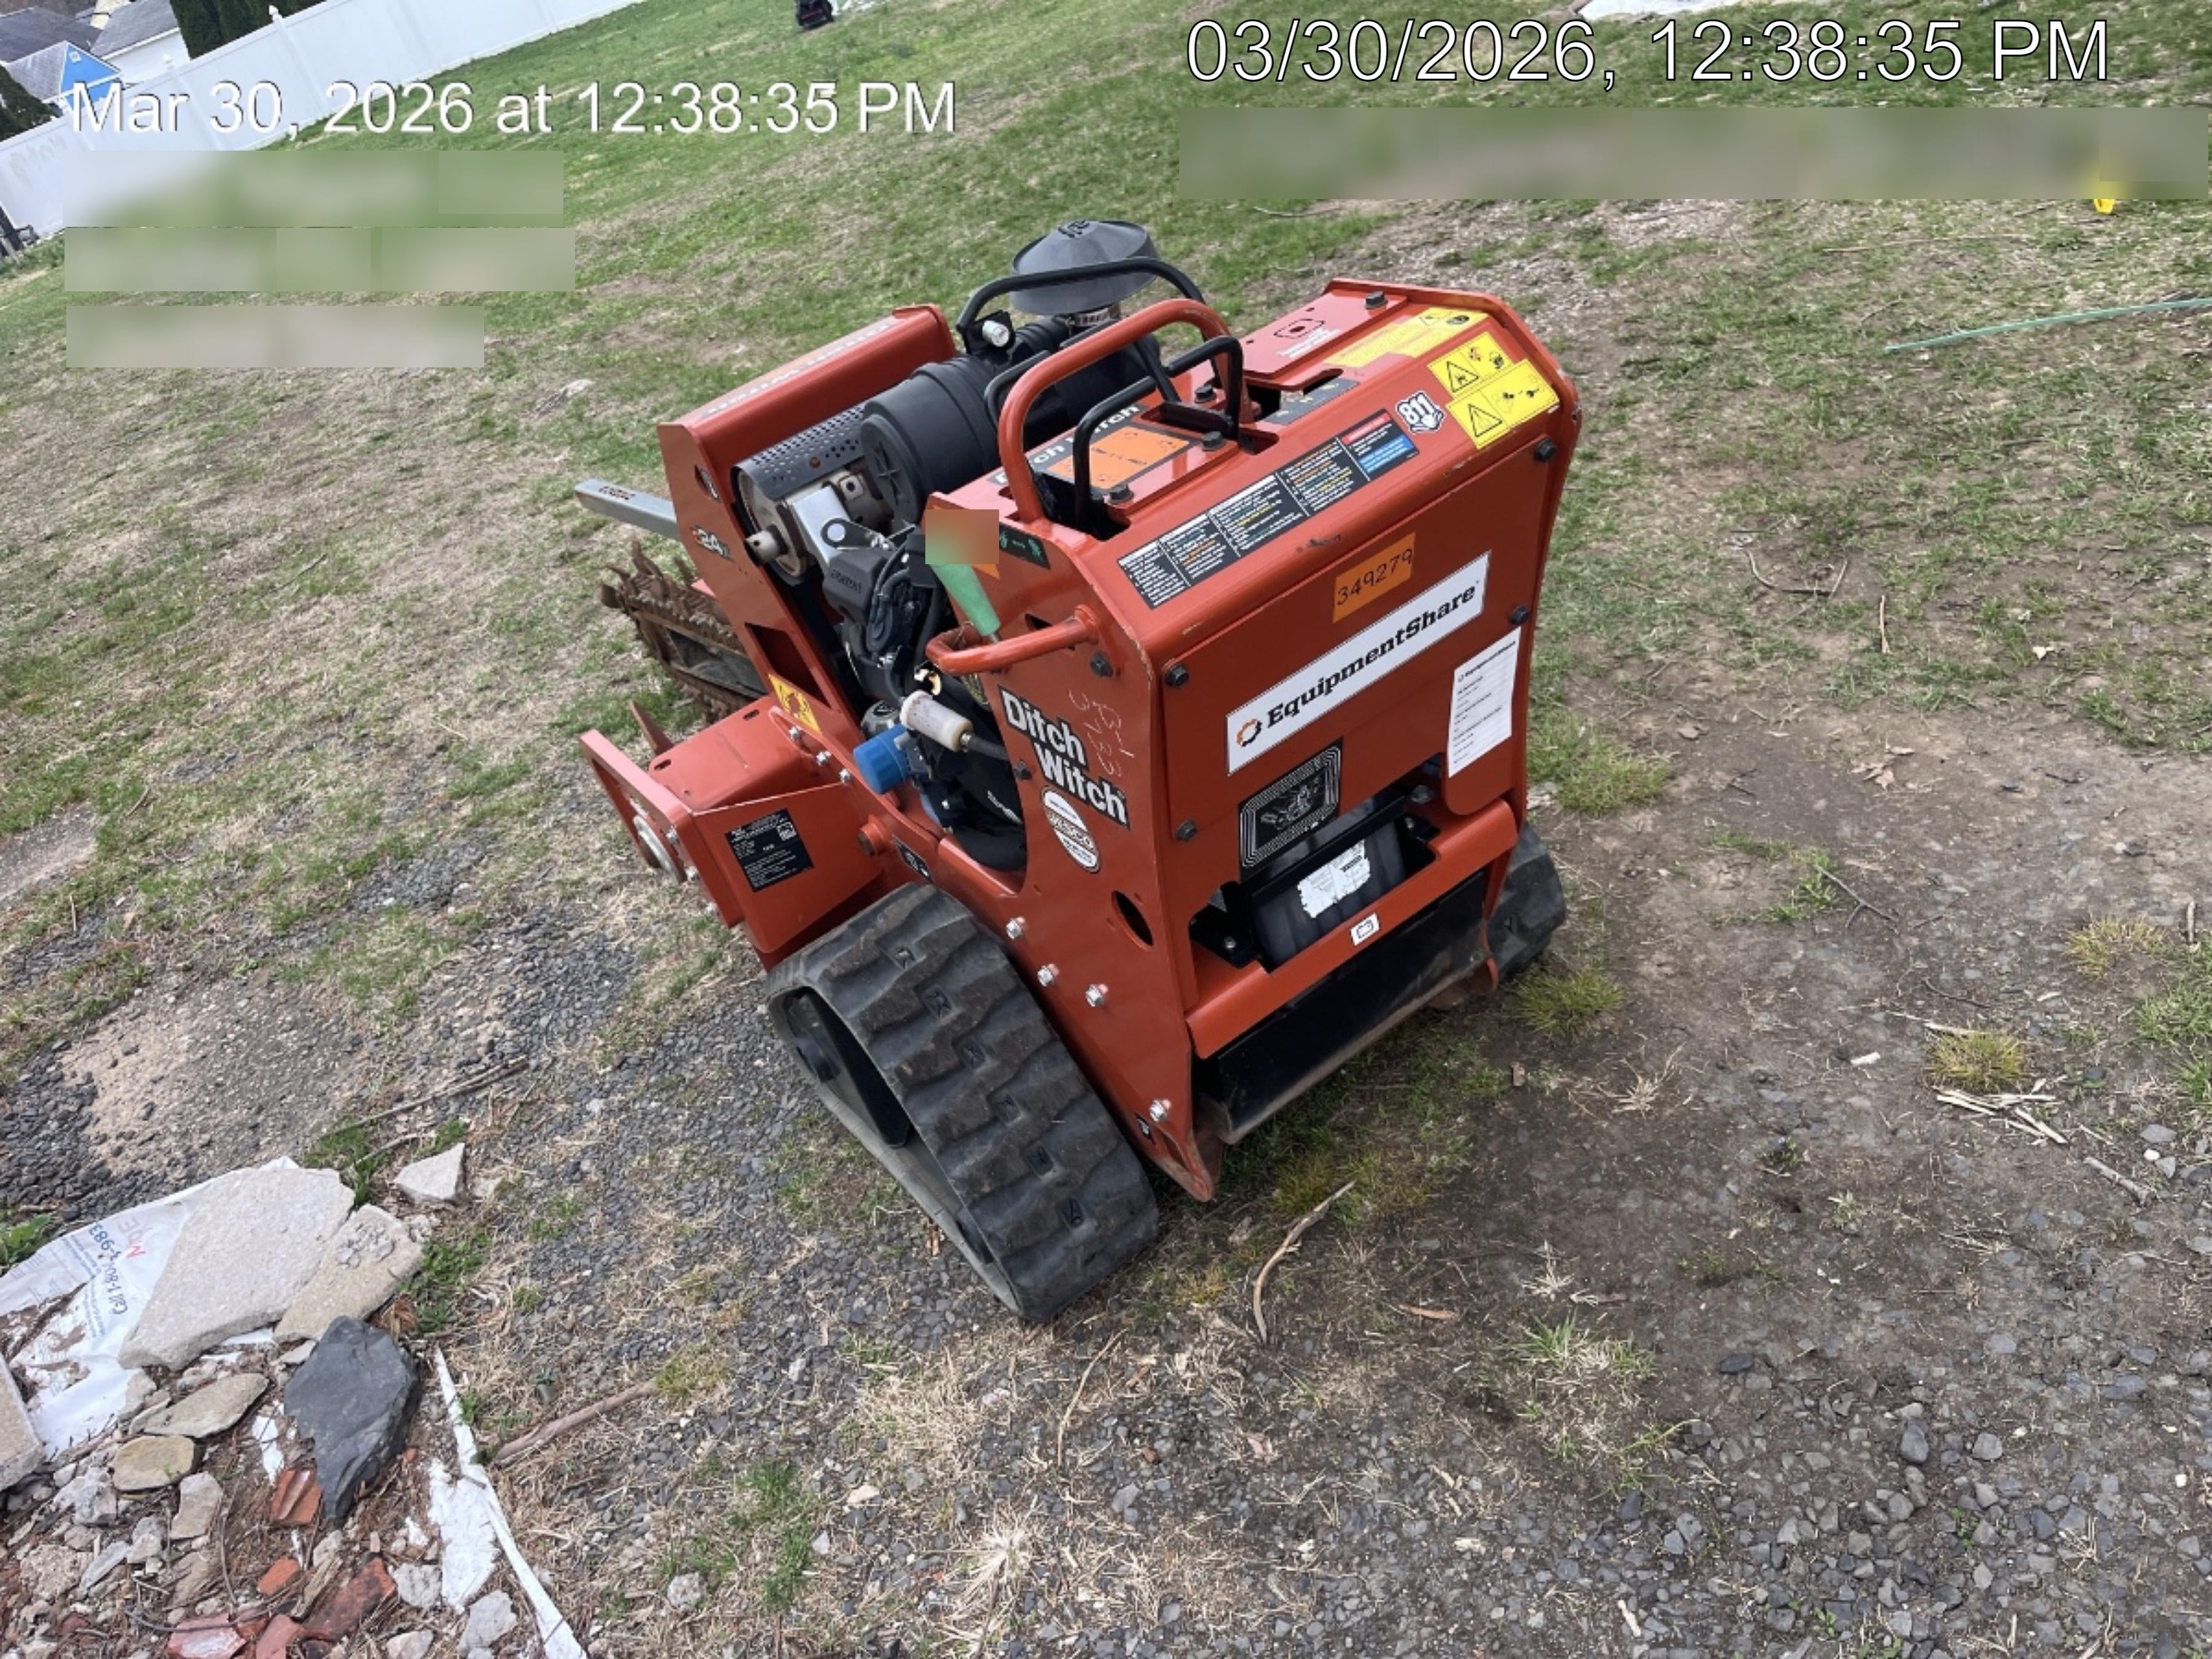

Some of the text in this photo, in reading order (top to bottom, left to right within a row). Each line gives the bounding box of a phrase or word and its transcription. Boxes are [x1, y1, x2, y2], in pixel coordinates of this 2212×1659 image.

[1398, 394, 1436, 425] 811
[1336, 548, 1413, 606] 349279
[1266, 584, 1477, 728] EquipmentShare
[1001, 690, 1087, 766] Ditch
[1033, 742, 1127, 825] Witch
